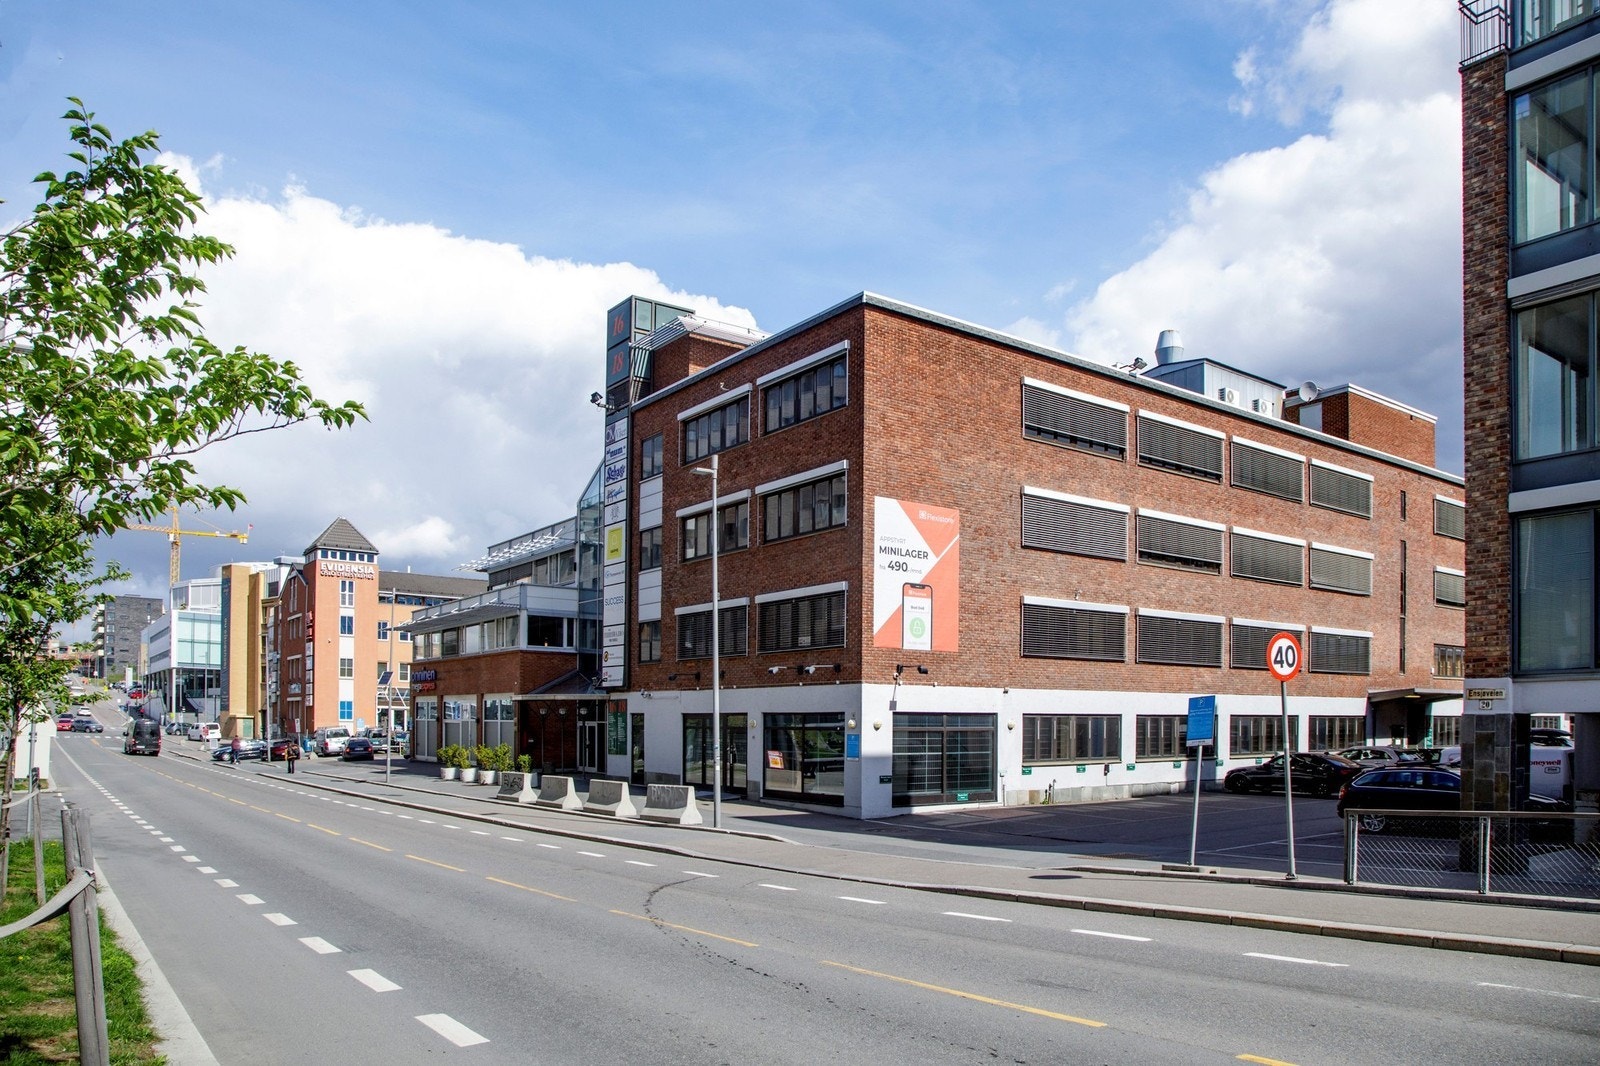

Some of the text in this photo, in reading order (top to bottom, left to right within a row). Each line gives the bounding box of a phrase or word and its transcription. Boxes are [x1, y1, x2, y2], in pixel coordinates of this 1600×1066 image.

[613, 312, 625, 336] 16
[611, 351, 624, 375] 18
[879, 545, 929, 560] MINILAGER
[321, 563, 375, 574] EVIDENSIA
[605, 595, 624, 607] SUCCESS
[1273, 645, 1296, 668] 40
[1468, 689, 1503, 698] Ensjøveien
[1480, 701, 1490, 709] 20
